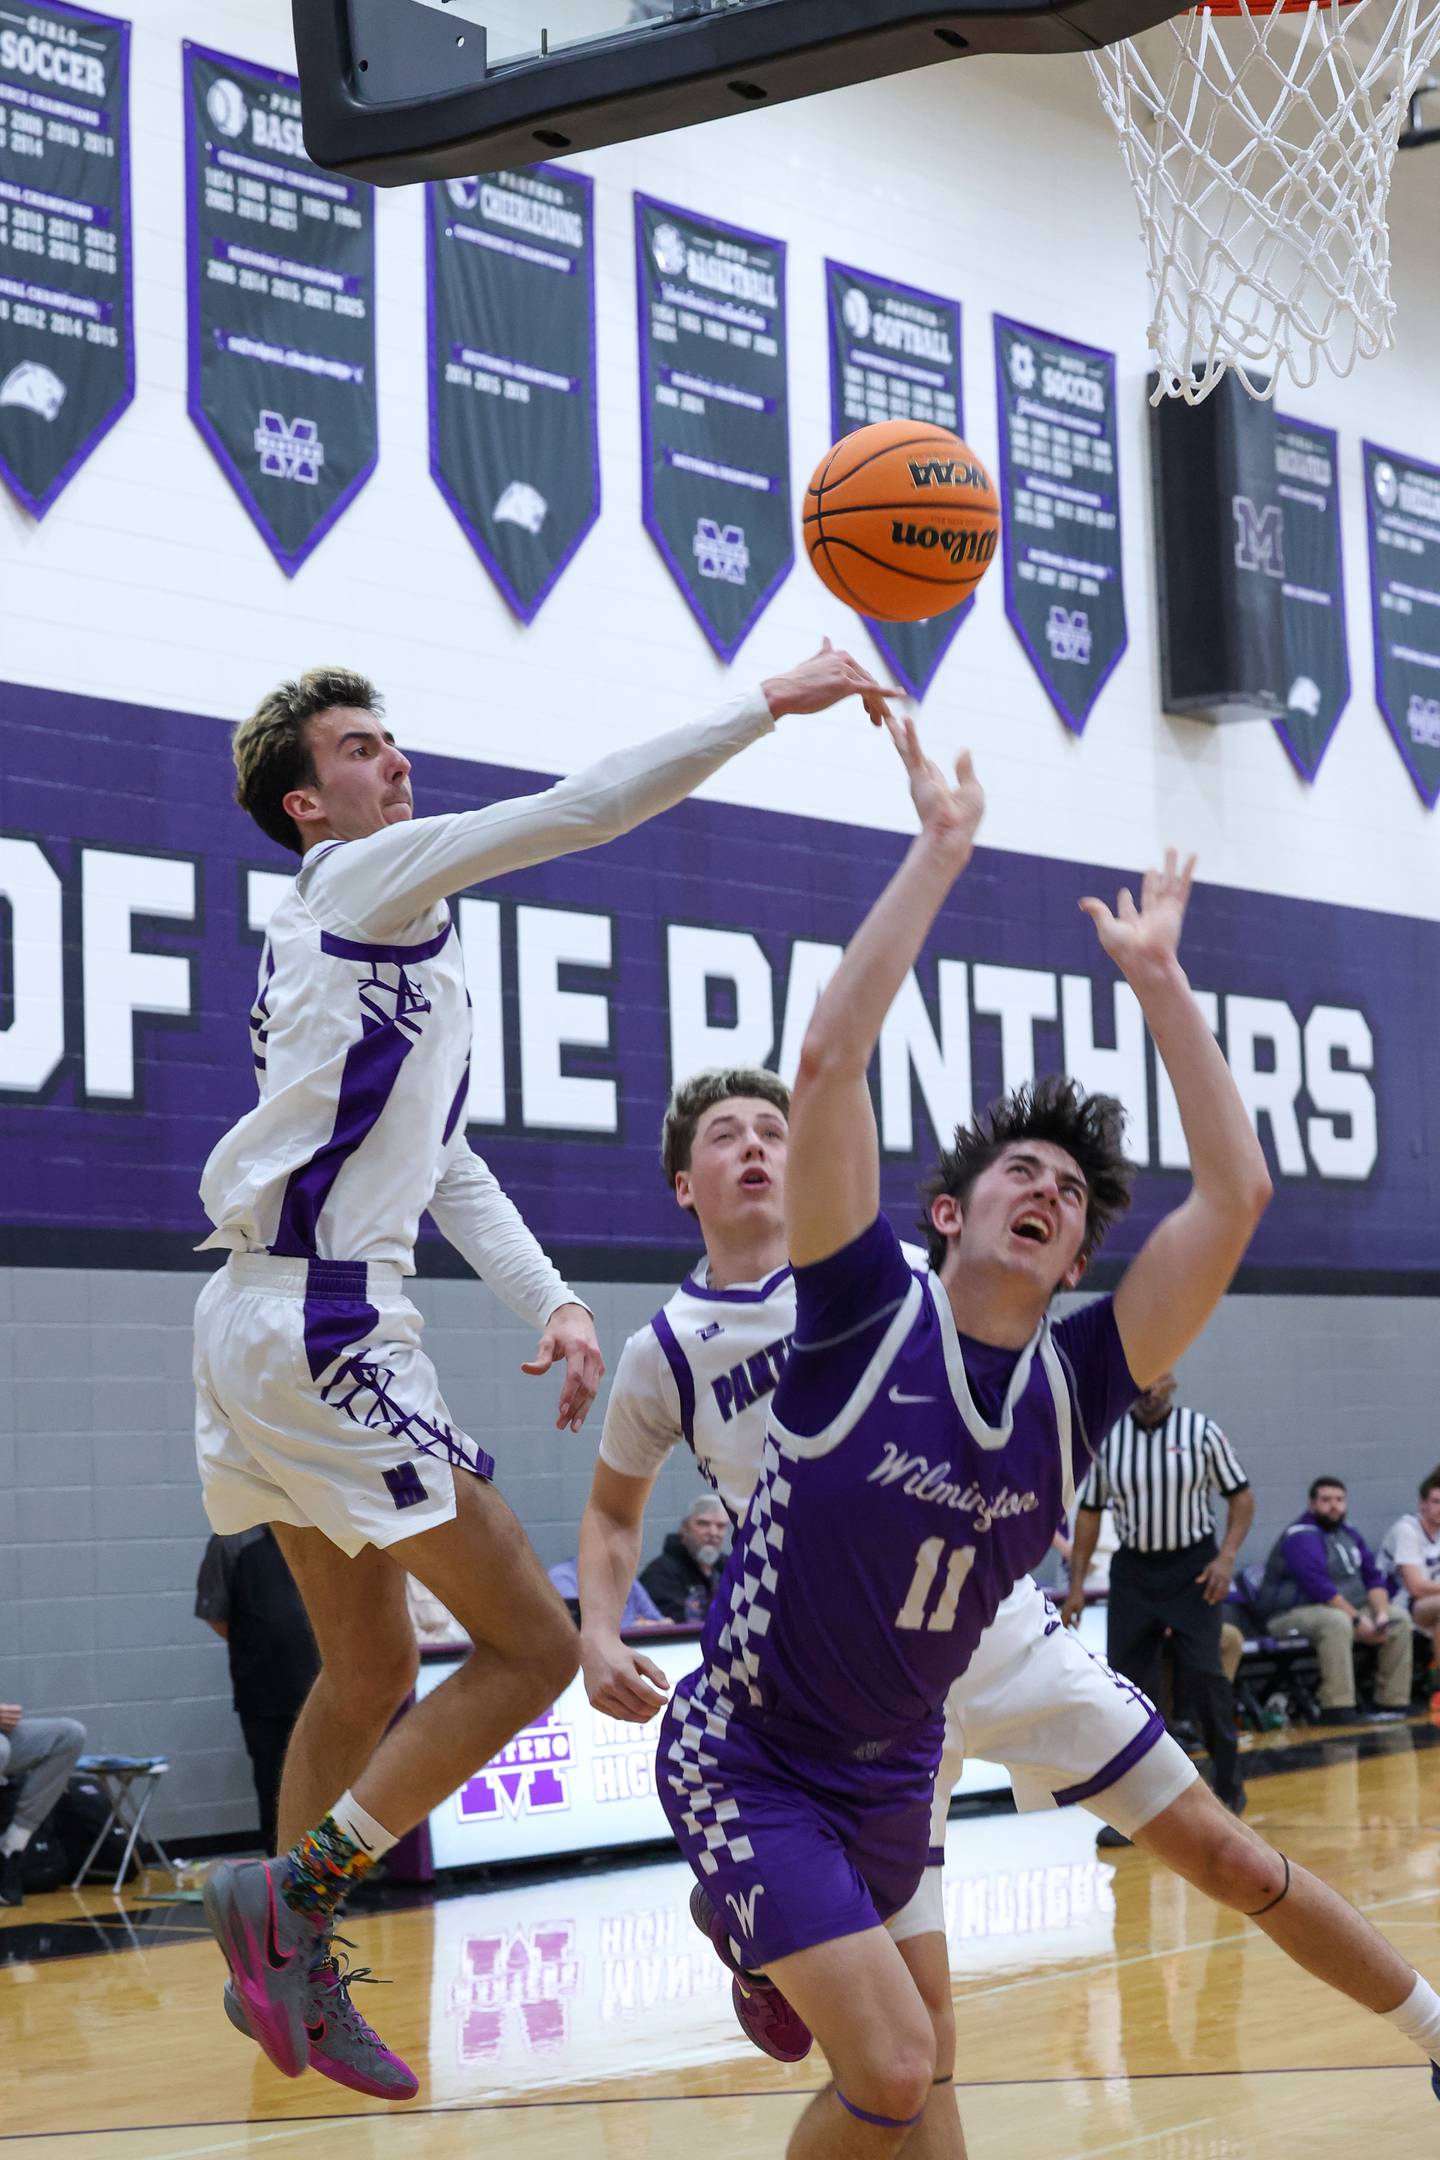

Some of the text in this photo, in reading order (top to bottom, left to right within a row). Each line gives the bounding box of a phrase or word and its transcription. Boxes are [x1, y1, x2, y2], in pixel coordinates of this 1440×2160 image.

[26, 15, 79, 47] GIRLS
[0, 29, 106, 98] SOCCER
[872, 313, 953, 365] SOFTBALL
[1041, 366, 1105, 414] SOCCER
[906, 458, 990, 494] NCAA
[891, 520, 998, 565] Wilson
[1232, 495, 1286, 579] M
[0, 836, 195, 1099] OF
[866, 1441, 1040, 1533] Wilmington
[894, 1536, 977, 1632] 11
[592, 1750, 661, 1804] HIG
[726, 1883, 765, 1941] W
